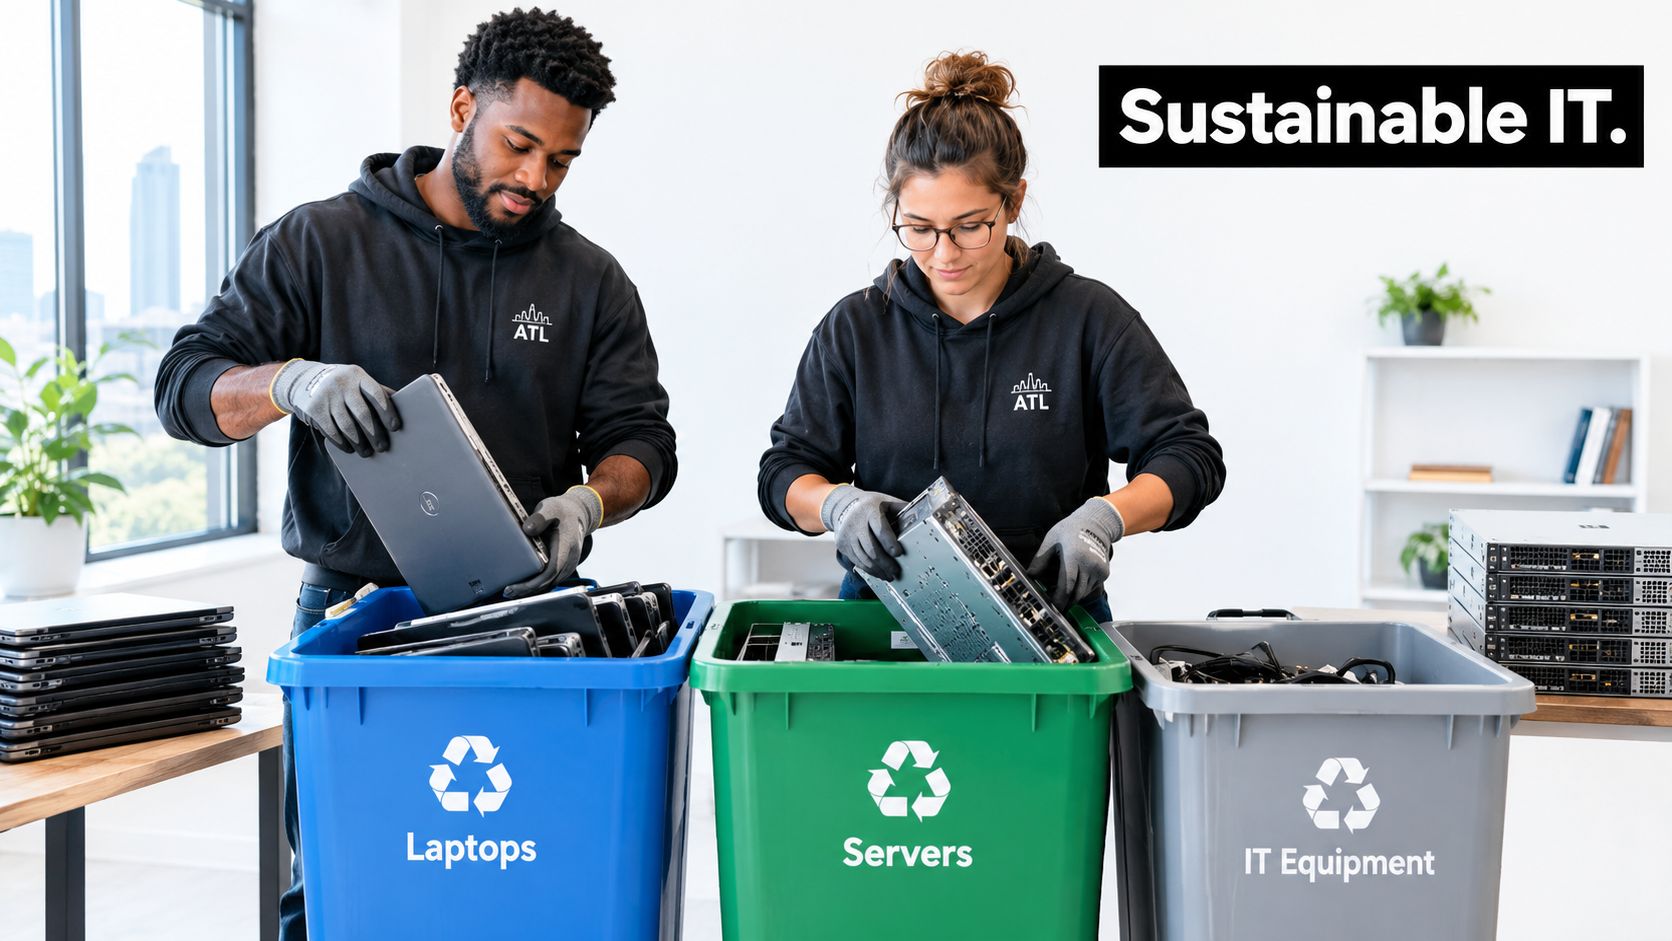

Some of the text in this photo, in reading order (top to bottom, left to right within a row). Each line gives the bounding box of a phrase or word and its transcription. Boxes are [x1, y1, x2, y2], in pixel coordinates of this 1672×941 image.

[513, 323, 549, 343] ATL
[1013, 393, 1050, 411] ATL
[407, 831, 537, 870] Laptops
[843, 836, 973, 868] Servers
[1245, 847, 1435, 883] IT Equipment
